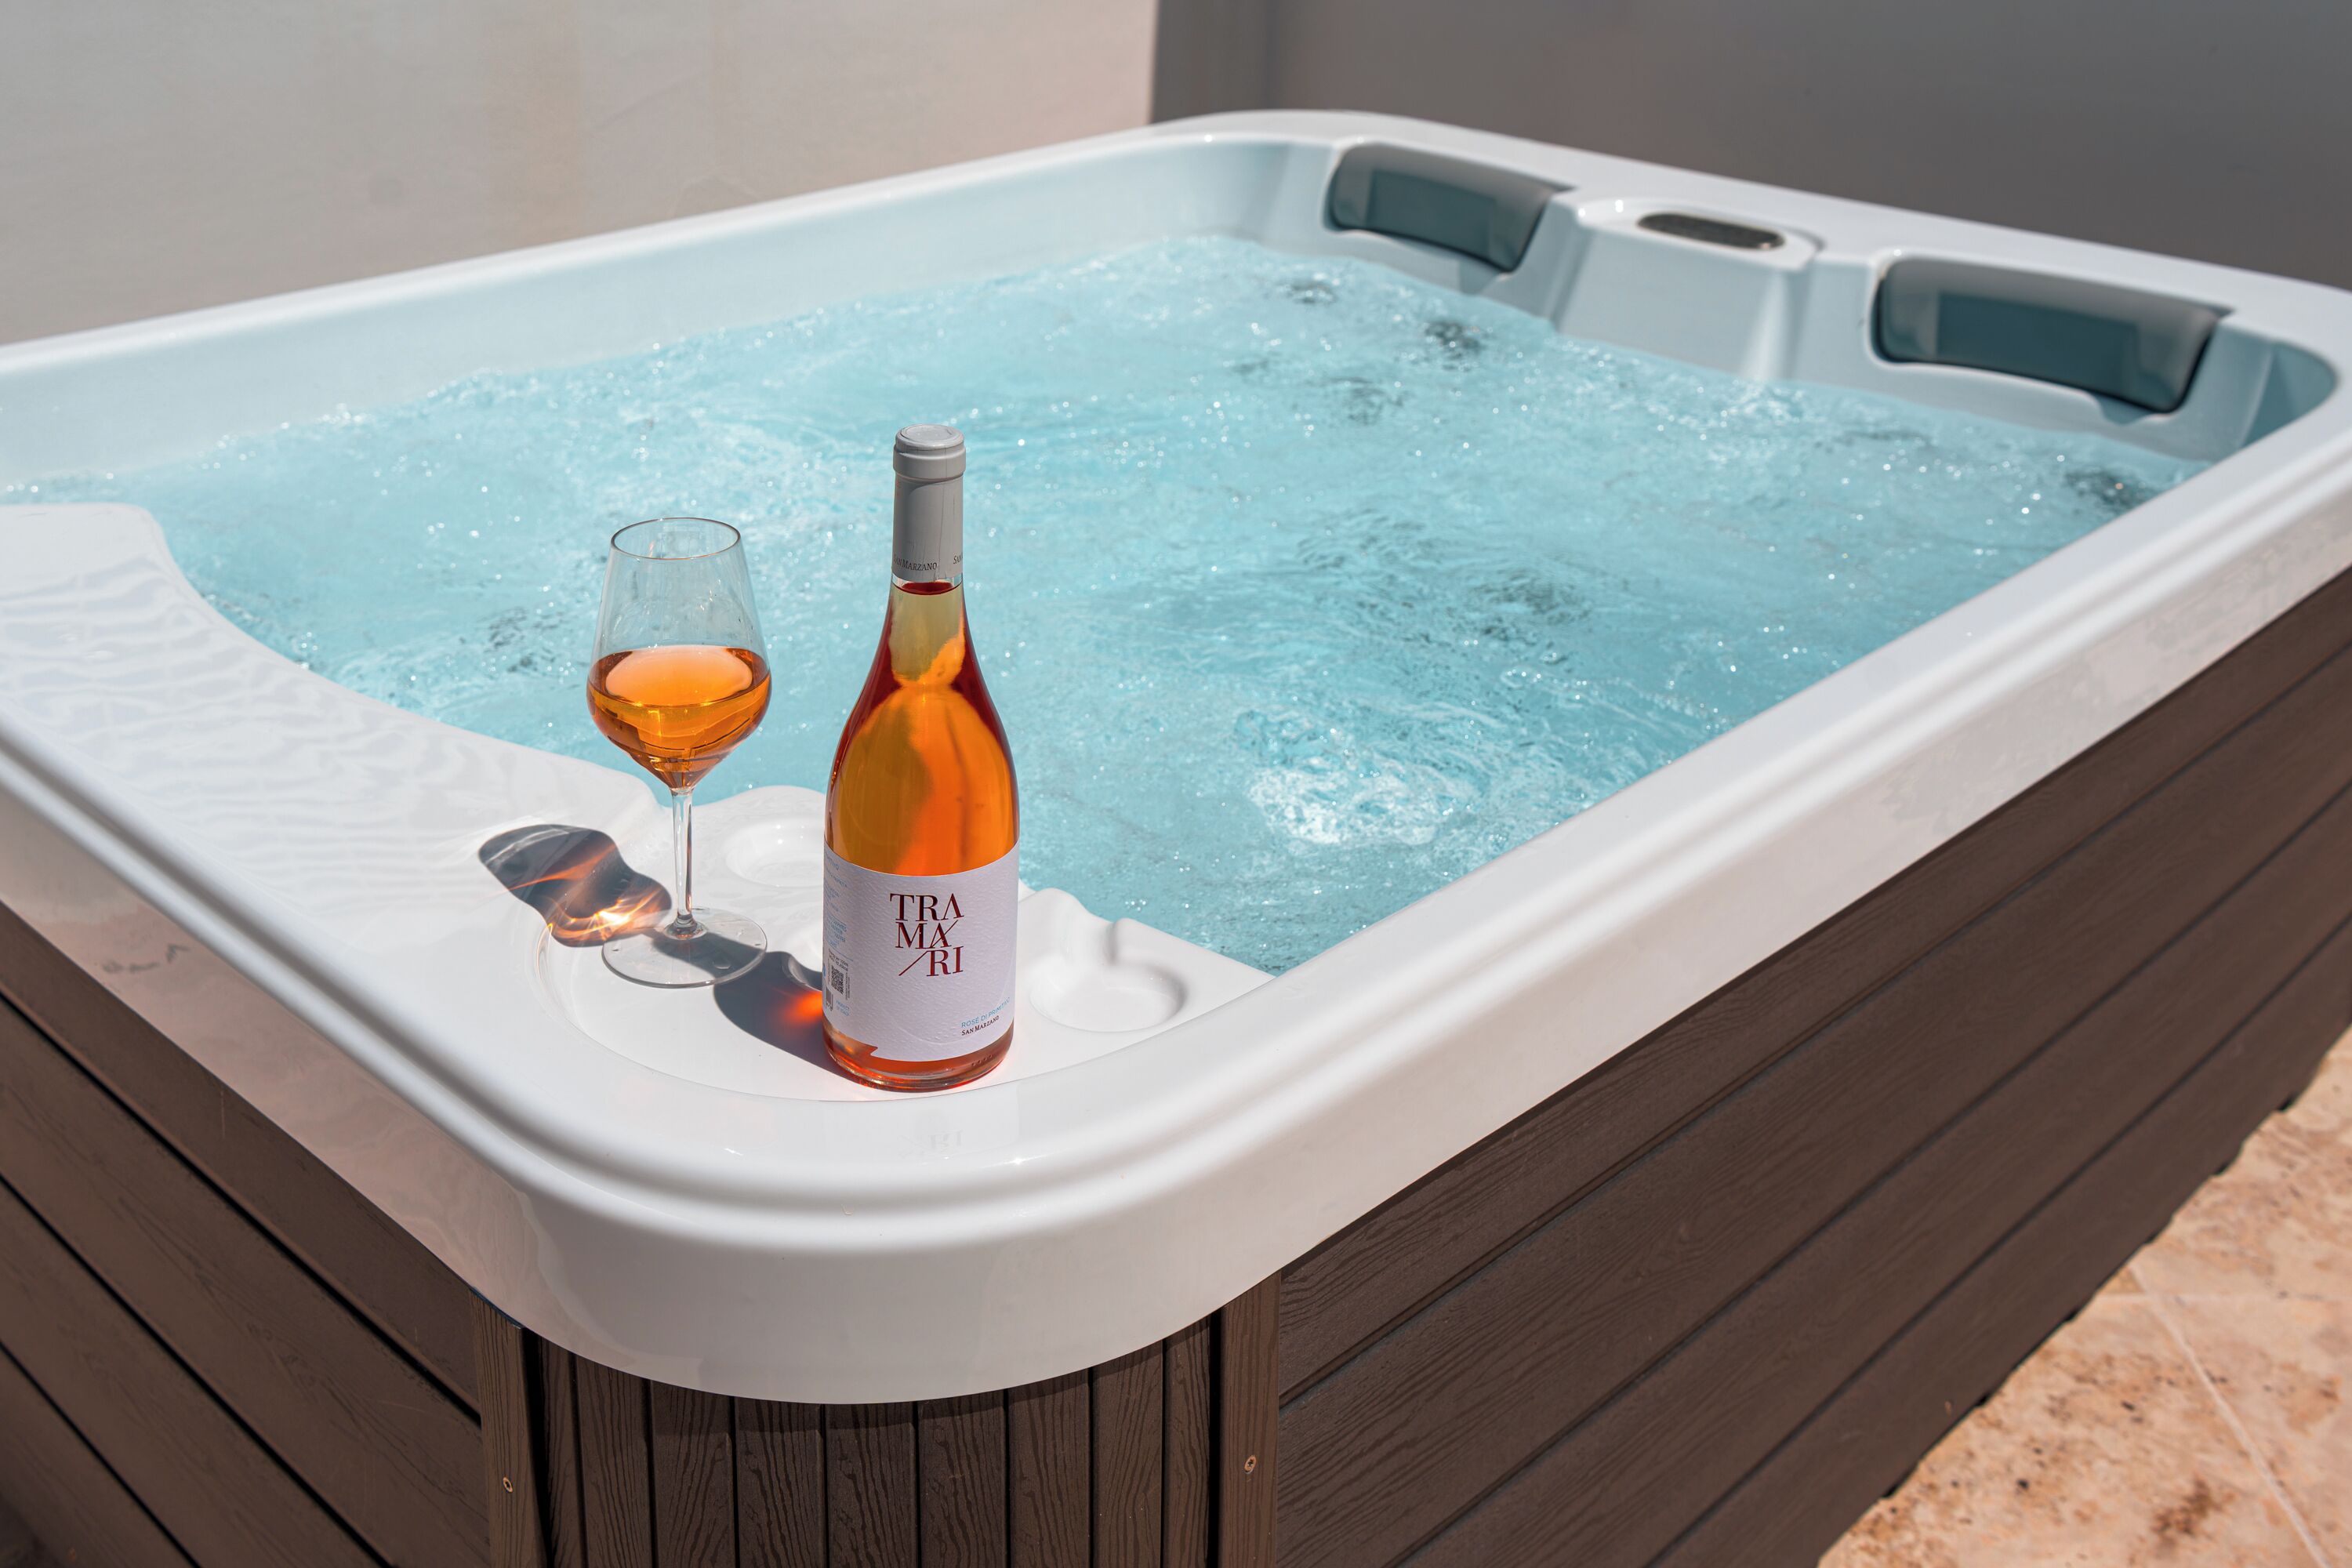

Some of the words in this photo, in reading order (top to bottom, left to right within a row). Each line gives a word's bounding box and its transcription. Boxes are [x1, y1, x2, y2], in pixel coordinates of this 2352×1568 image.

[902, 559, 938, 572] MARZANO
[890, 893, 964, 921] TRA
[975, 1015, 1000, 1032] MARZANO
